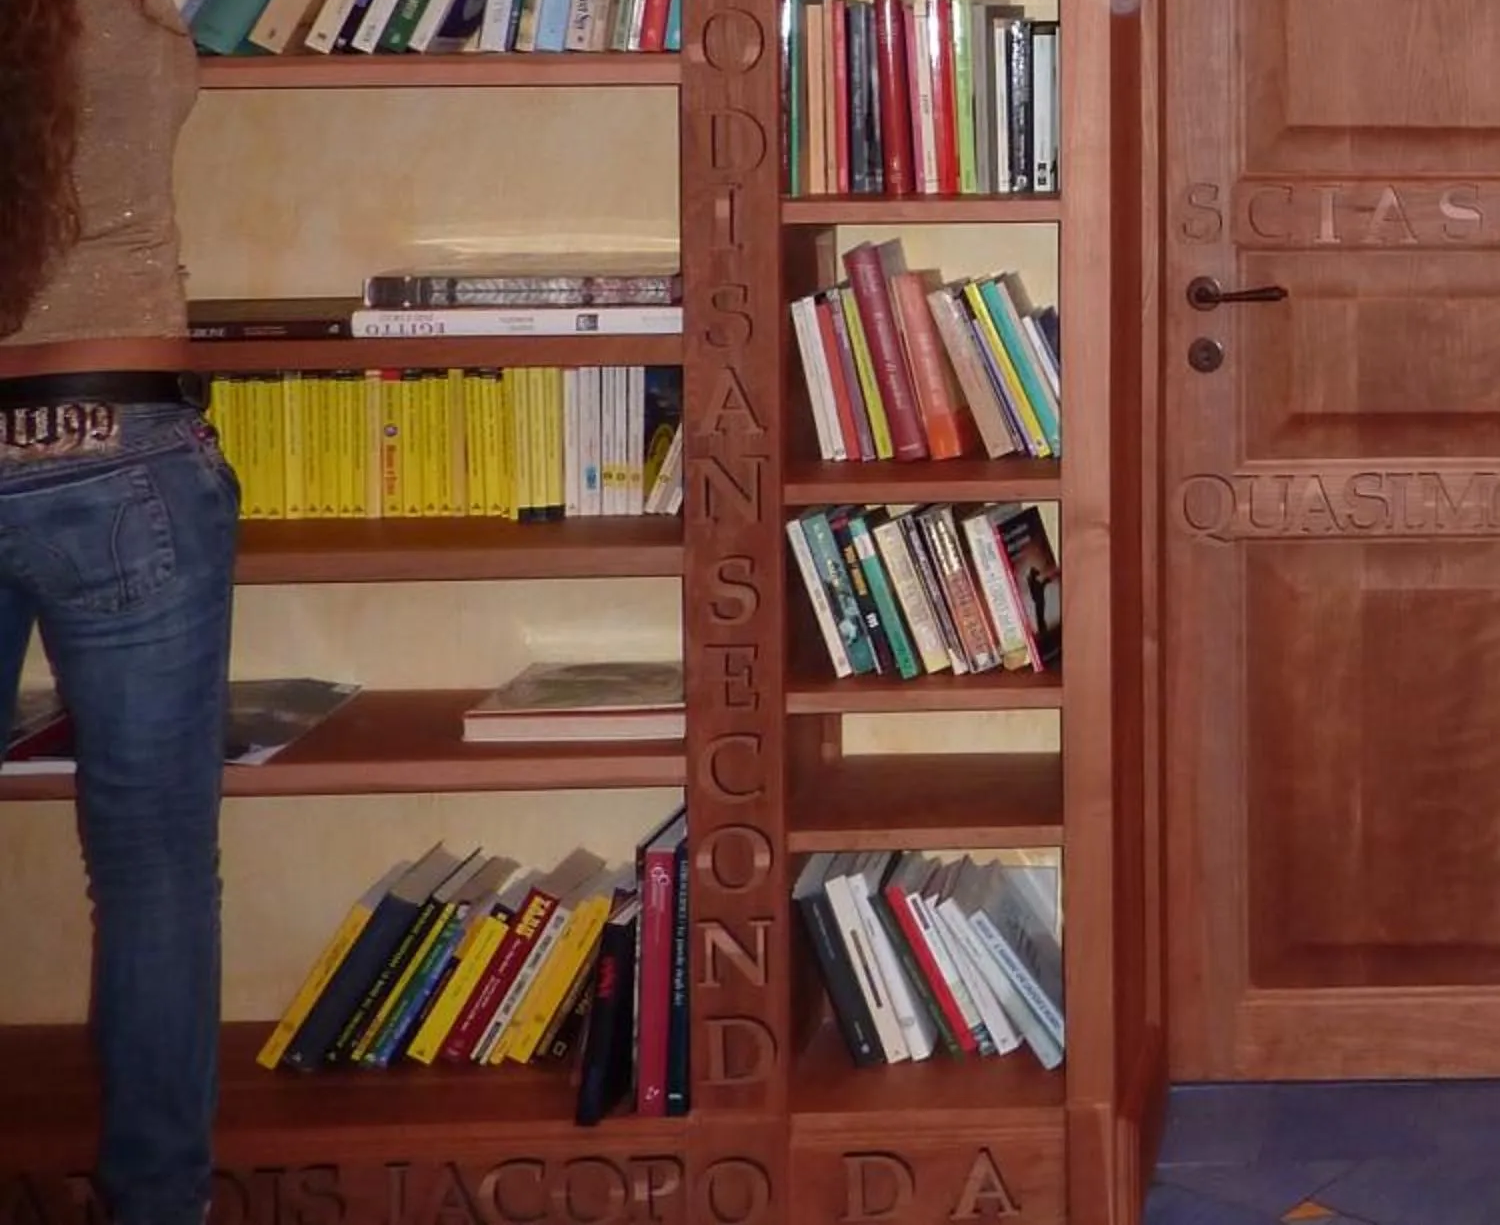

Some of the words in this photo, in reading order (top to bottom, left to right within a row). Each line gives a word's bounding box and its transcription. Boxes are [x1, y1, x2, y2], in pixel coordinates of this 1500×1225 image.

[705, 107, 768, 251] DI
[698, 282, 770, 528] SAN
[838, 1146, 1022, 1224] DA
